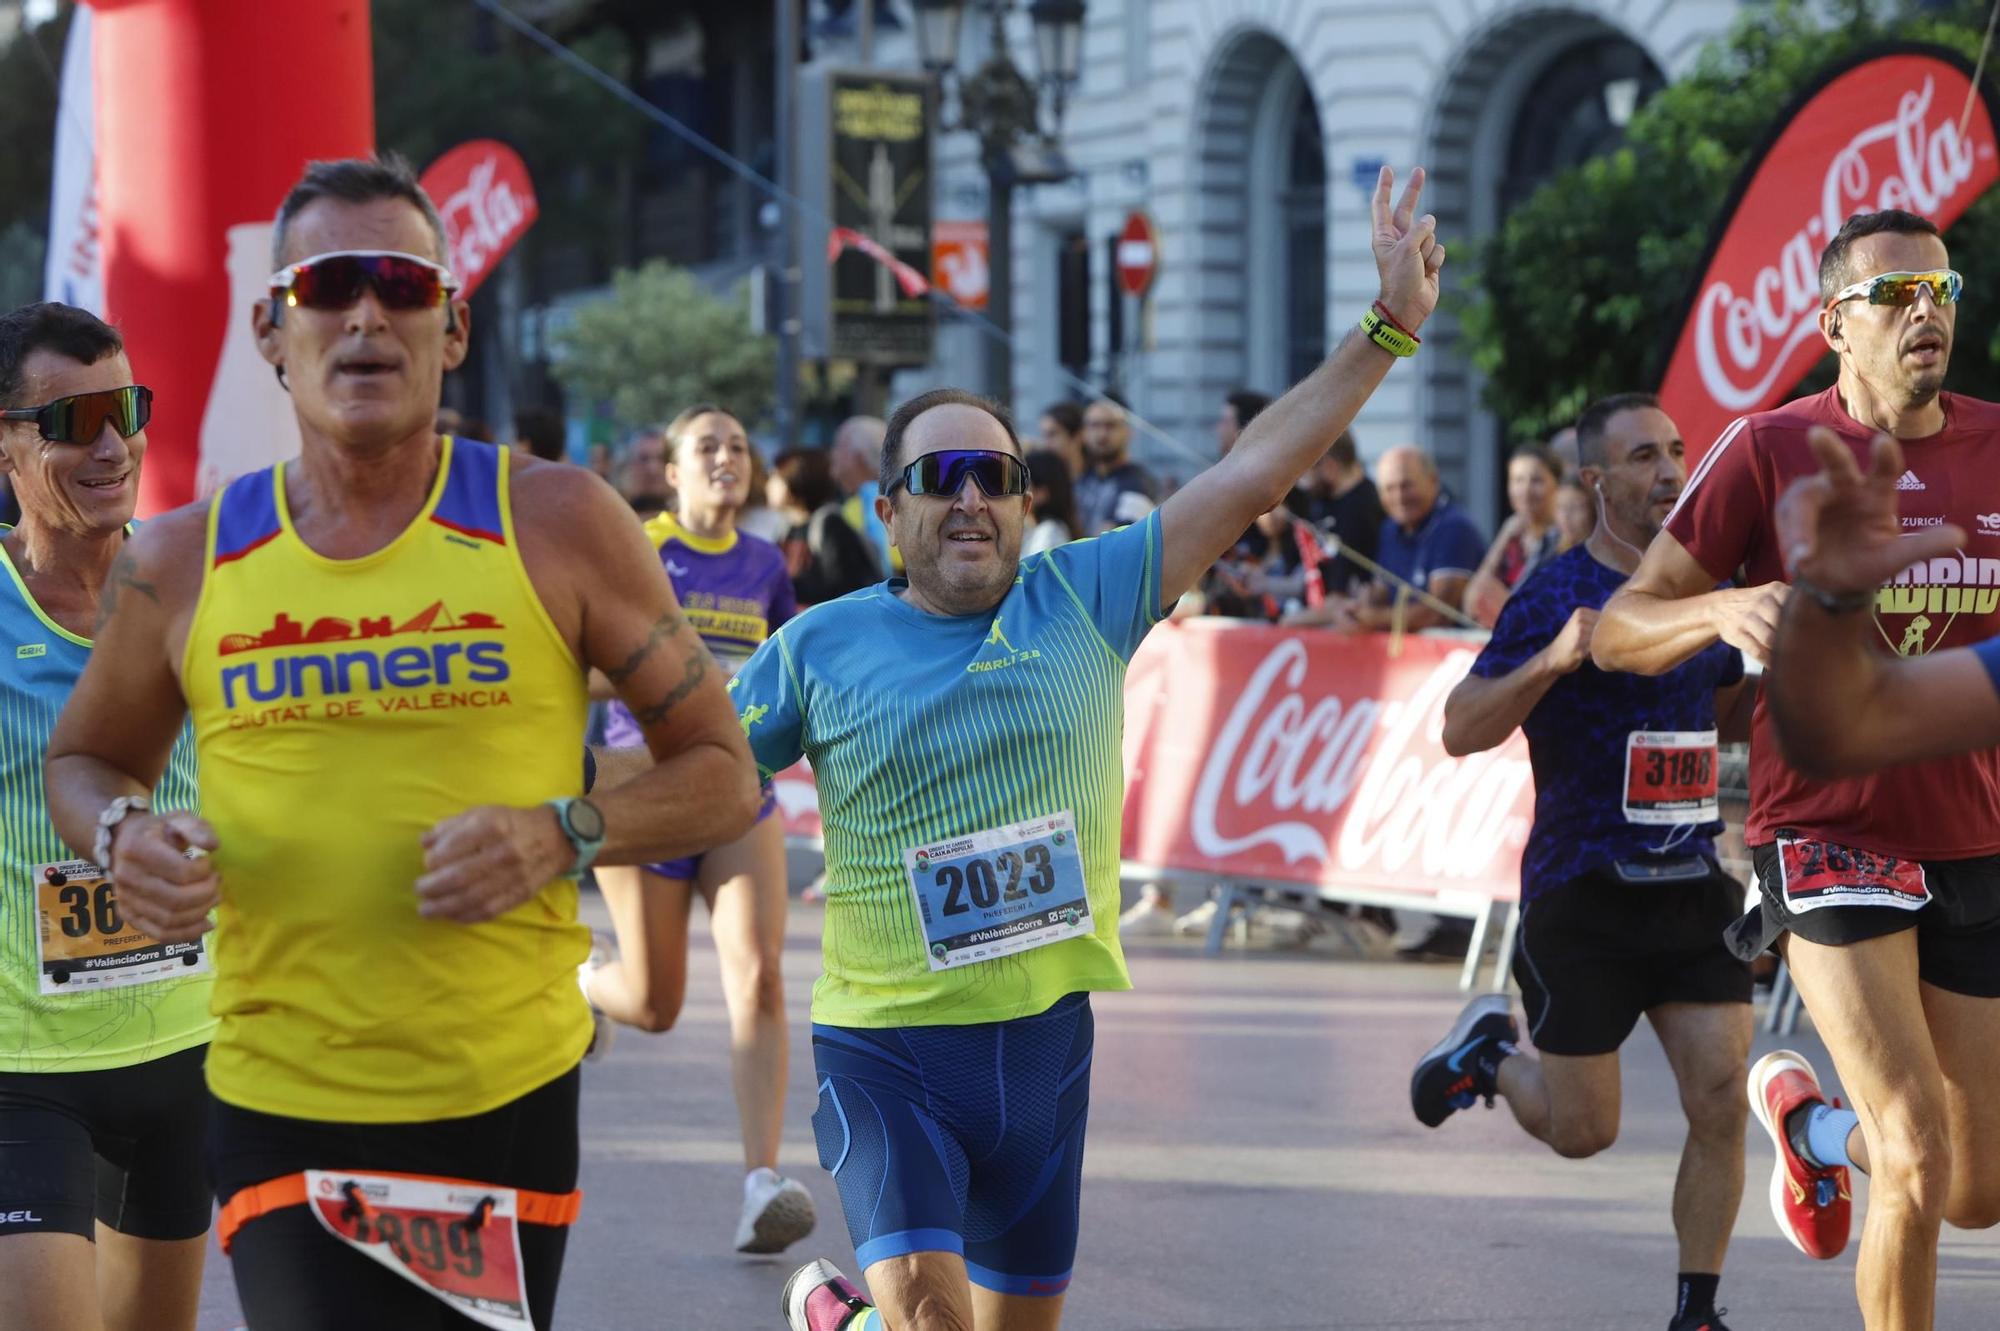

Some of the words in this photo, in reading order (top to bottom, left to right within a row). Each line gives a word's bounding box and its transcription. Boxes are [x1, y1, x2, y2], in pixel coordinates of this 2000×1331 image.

[1902, 517, 1943, 526] ZURICH
[221, 641, 510, 709] runners
[966, 655, 1016, 673] CHARLI
[229, 703, 311, 730] CIUTAT
[325, 700, 364, 720] DE
[935, 843, 1055, 917] 2023
[969, 918, 1043, 943] #ValènciaCorre
[85, 951, 160, 968] #ValènciaCorre
